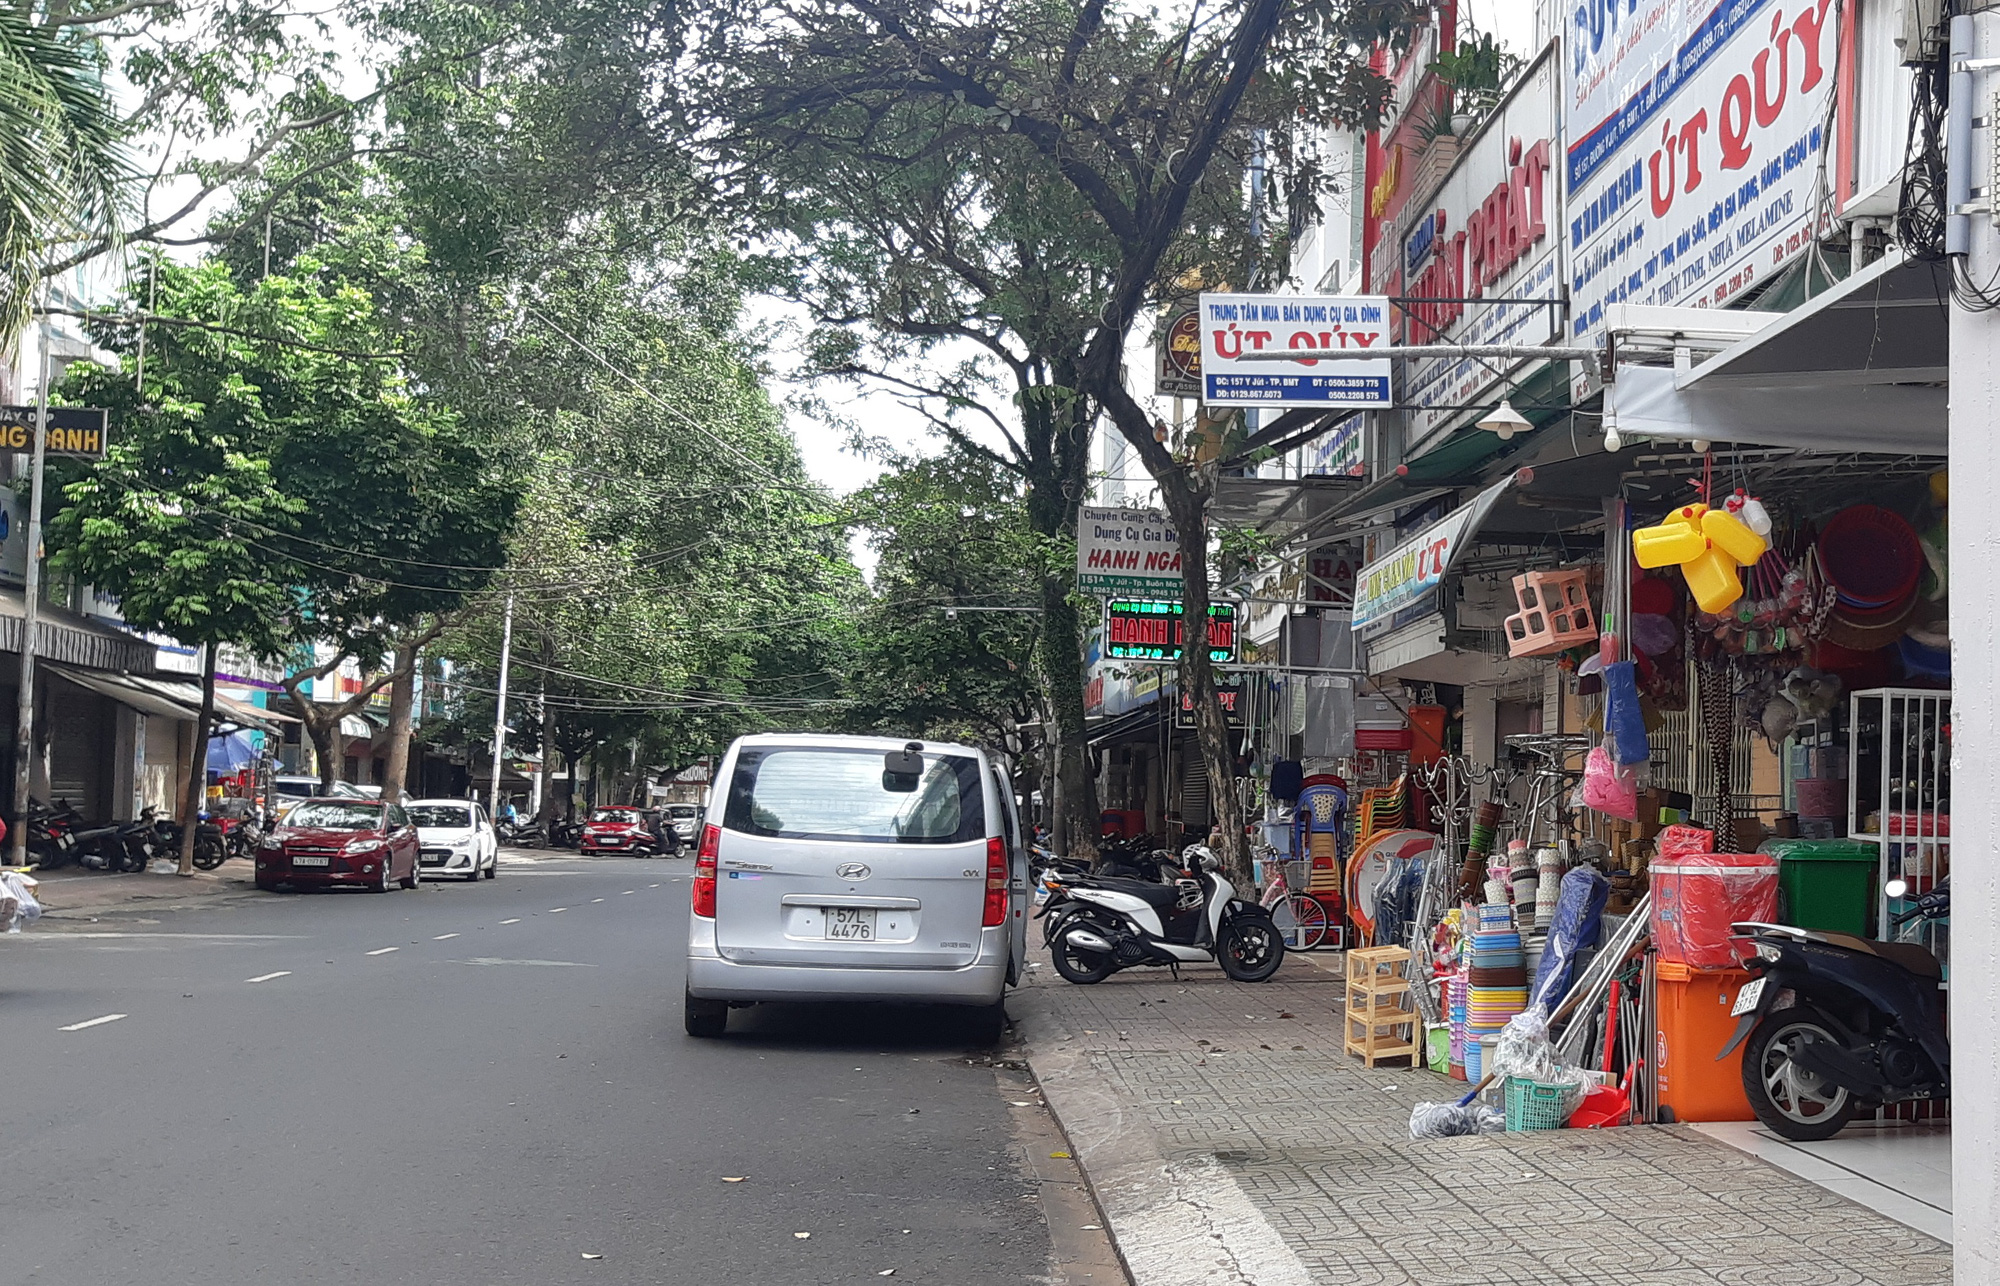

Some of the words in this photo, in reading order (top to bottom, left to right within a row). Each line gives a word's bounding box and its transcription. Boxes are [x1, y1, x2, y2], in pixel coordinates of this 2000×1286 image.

[1648, 107, 1707, 219] ÚT
[1718, 0, 1829, 171] QUÝ
[1467, 135, 1550, 300] PHÁT
[1682, 255, 1706, 290] TINH,
[1736, 189, 1793, 251] MELAMINE
[1208, 304, 1238, 322] TRUNG
[1240, 301, 1259, 322] TÂM
[1261, 305, 1280, 322] MUA
[1283, 302, 1300, 323] BÁN
[1304, 306, 1327, 326] DỤNG
[1329, 306, 1342, 325] CỤ
[1343, 307, 1358, 323] GIA
[1361, 303, 1382, 324] ĐÌNH
[1212, 323, 1273, 360] ÚT
[1288, 324, 1380, 367] QUÝ
[1215, 377, 1229, 386] ĐC:
[1230, 377, 1244, 386] 157
[1245, 377, 1251, 386] Y
[1269, 378, 1282, 387] TP.
[1283, 378, 1300, 387] BMT
[1328, 379, 1364, 388] 0500.3859
[1366, 379, 1379, 388] 775
[1230, 390, 1283, 399] 0129.867.6073
[1328, 391, 1364, 400] 0500.2208
[1366, 391, 1379, 400] 575
[28, 411, 55, 423] DP
[1084, 509, 1118, 522] Chuyên
[1121, 511, 1144, 524] Cung
[1094, 525, 1122, 543] Dụng
[1125, 526, 1140, 544] Cụ
[1143, 528, 1161, 542] Gia
[1087, 548, 1140, 573] HẠNH
[1417, 537, 1448, 582] ÚT
[1110, 616, 1169, 649] HẠNH
[836, 908, 866, 924] 57L
[831, 924, 870, 939] 4476
